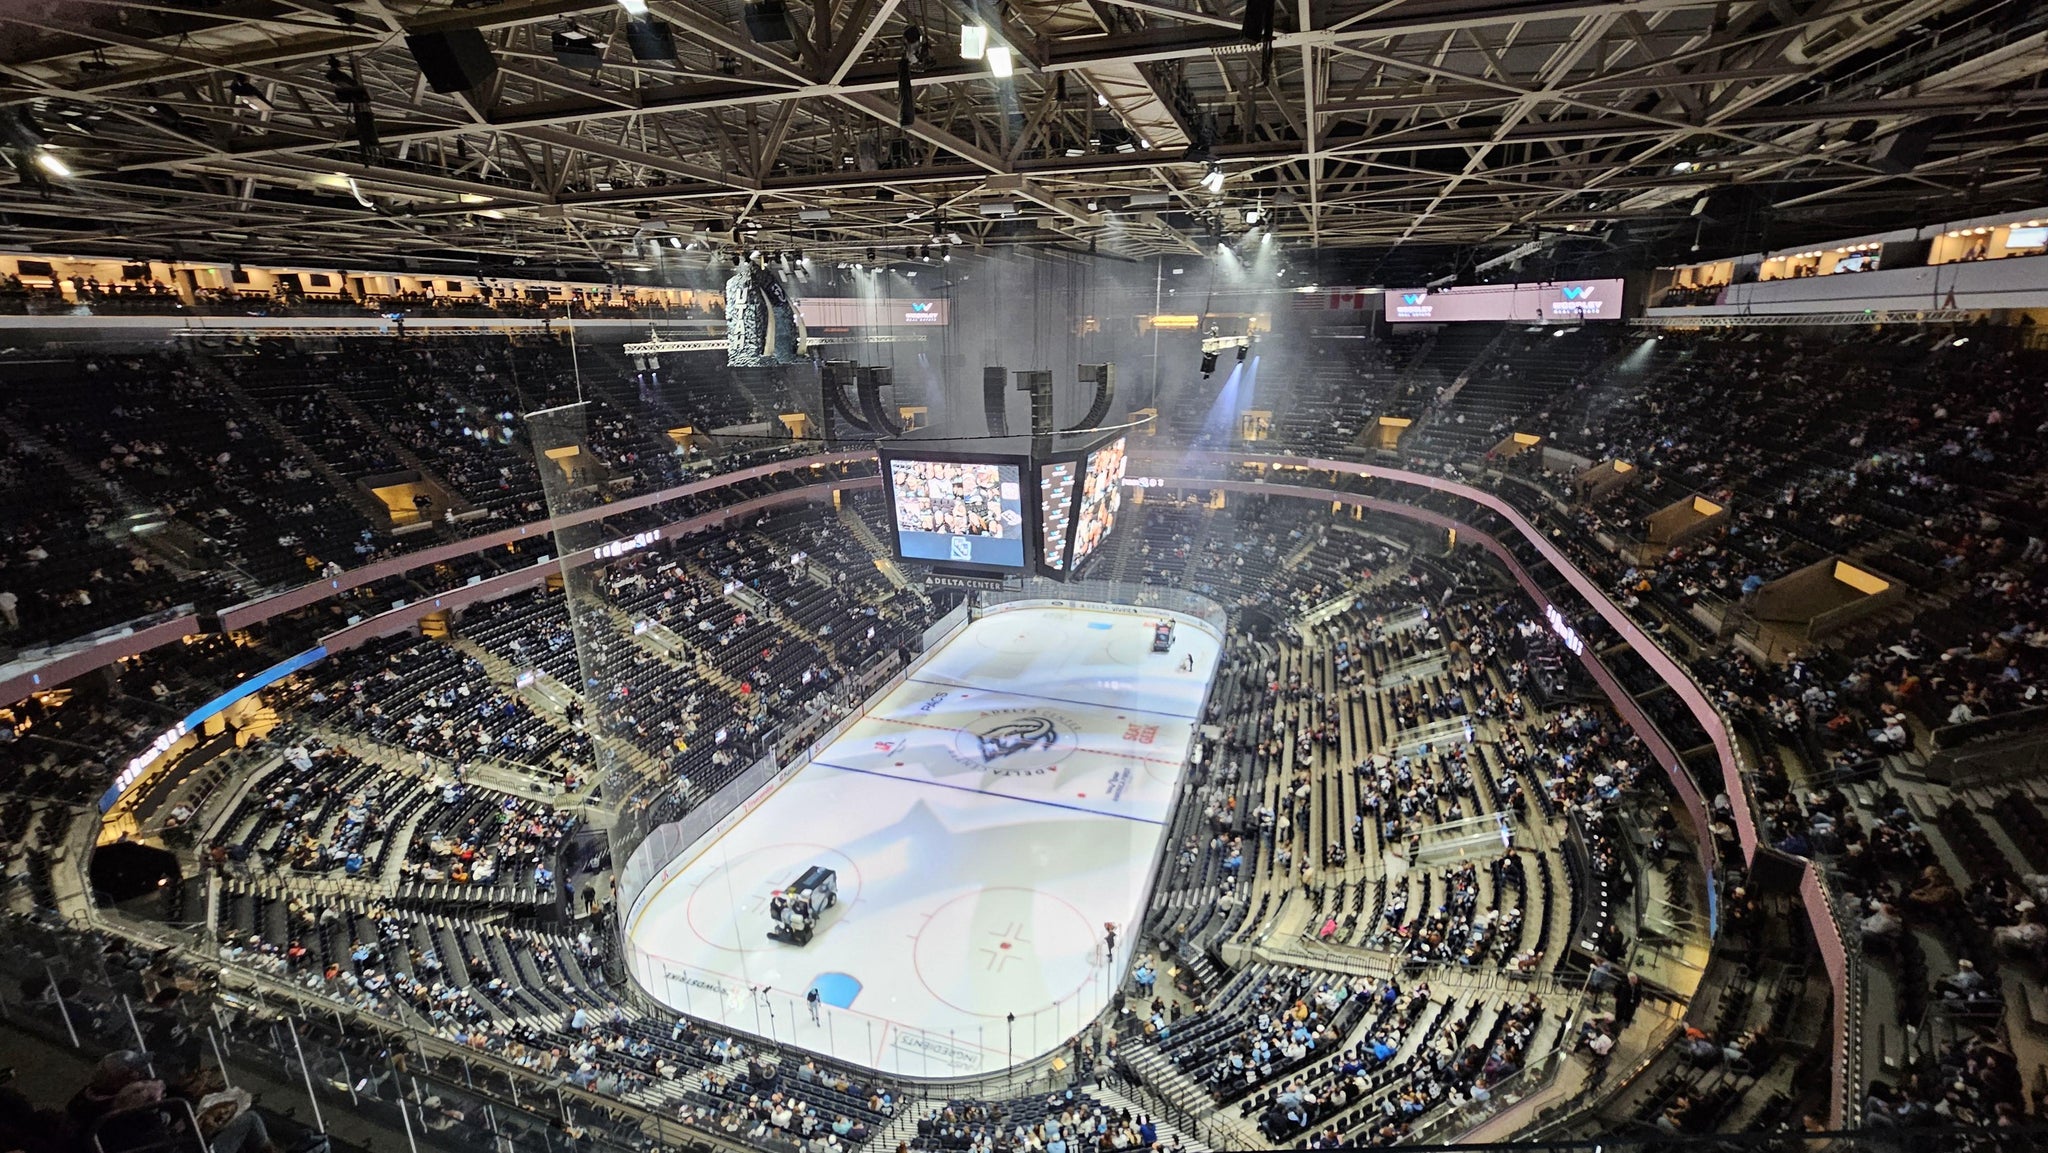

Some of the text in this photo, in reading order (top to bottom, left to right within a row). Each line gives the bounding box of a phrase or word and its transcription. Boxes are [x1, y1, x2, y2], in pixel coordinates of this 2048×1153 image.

[733, 287, 749, 351] UTAH
[935, 577, 1000, 589] DELTA CENTER
[921, 692, 948, 712] PACS
[993, 768, 1045, 776] DELTA
